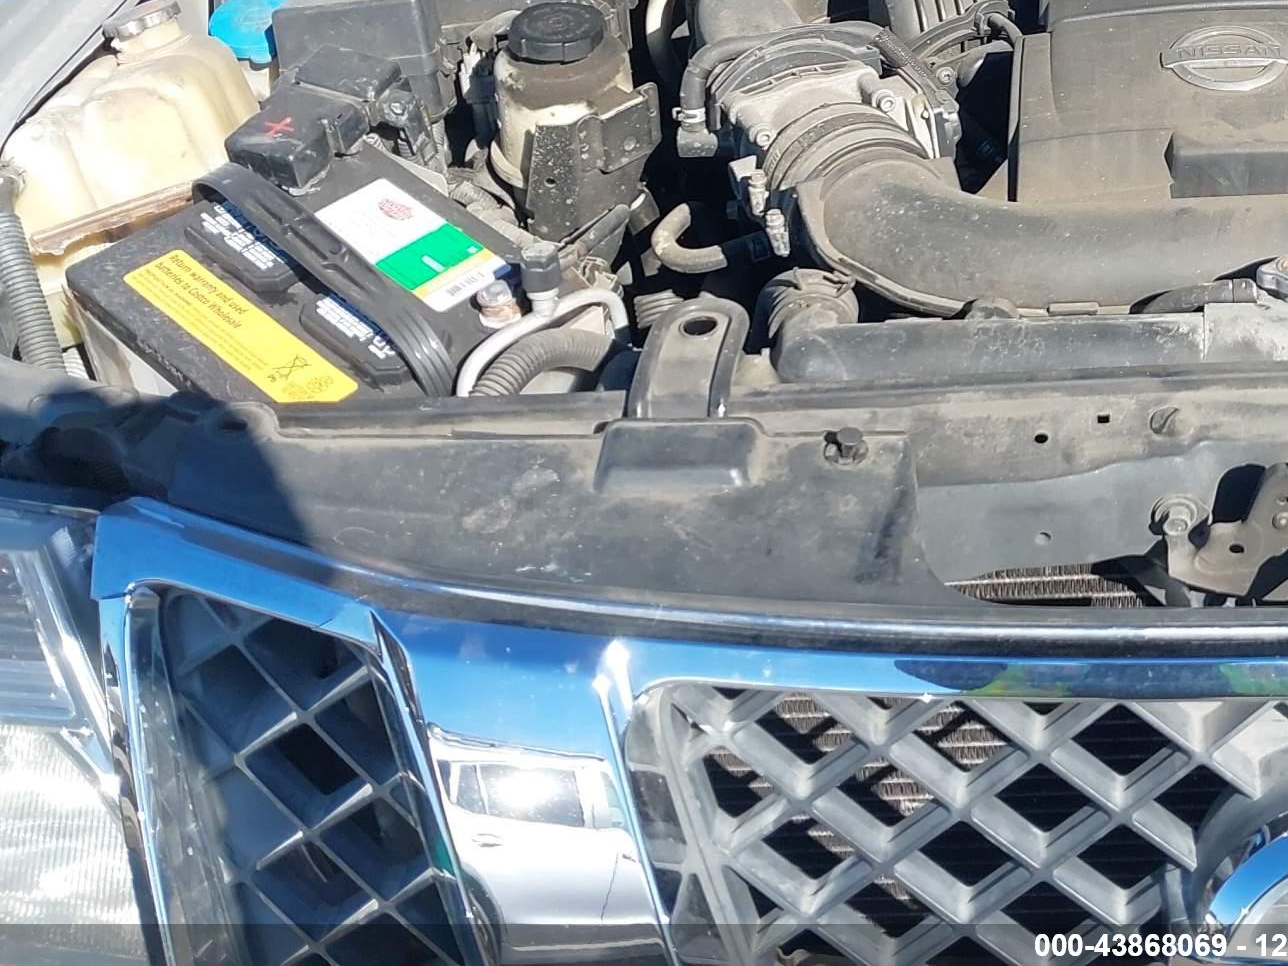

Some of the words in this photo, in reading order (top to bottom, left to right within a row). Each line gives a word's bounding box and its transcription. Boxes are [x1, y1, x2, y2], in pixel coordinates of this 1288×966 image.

[1178, 44, 1281, 59] NISSAN
[154, 262, 184, 285] batteries
[180, 282, 191, 291] to
[188, 287, 210, 305] Costco
[207, 303, 242, 329] Wholesale
[167, 254, 192, 273] Return
[189, 272, 218, 294] warranty
[215, 292, 234, 304] and
[228, 301, 248, 315] used
